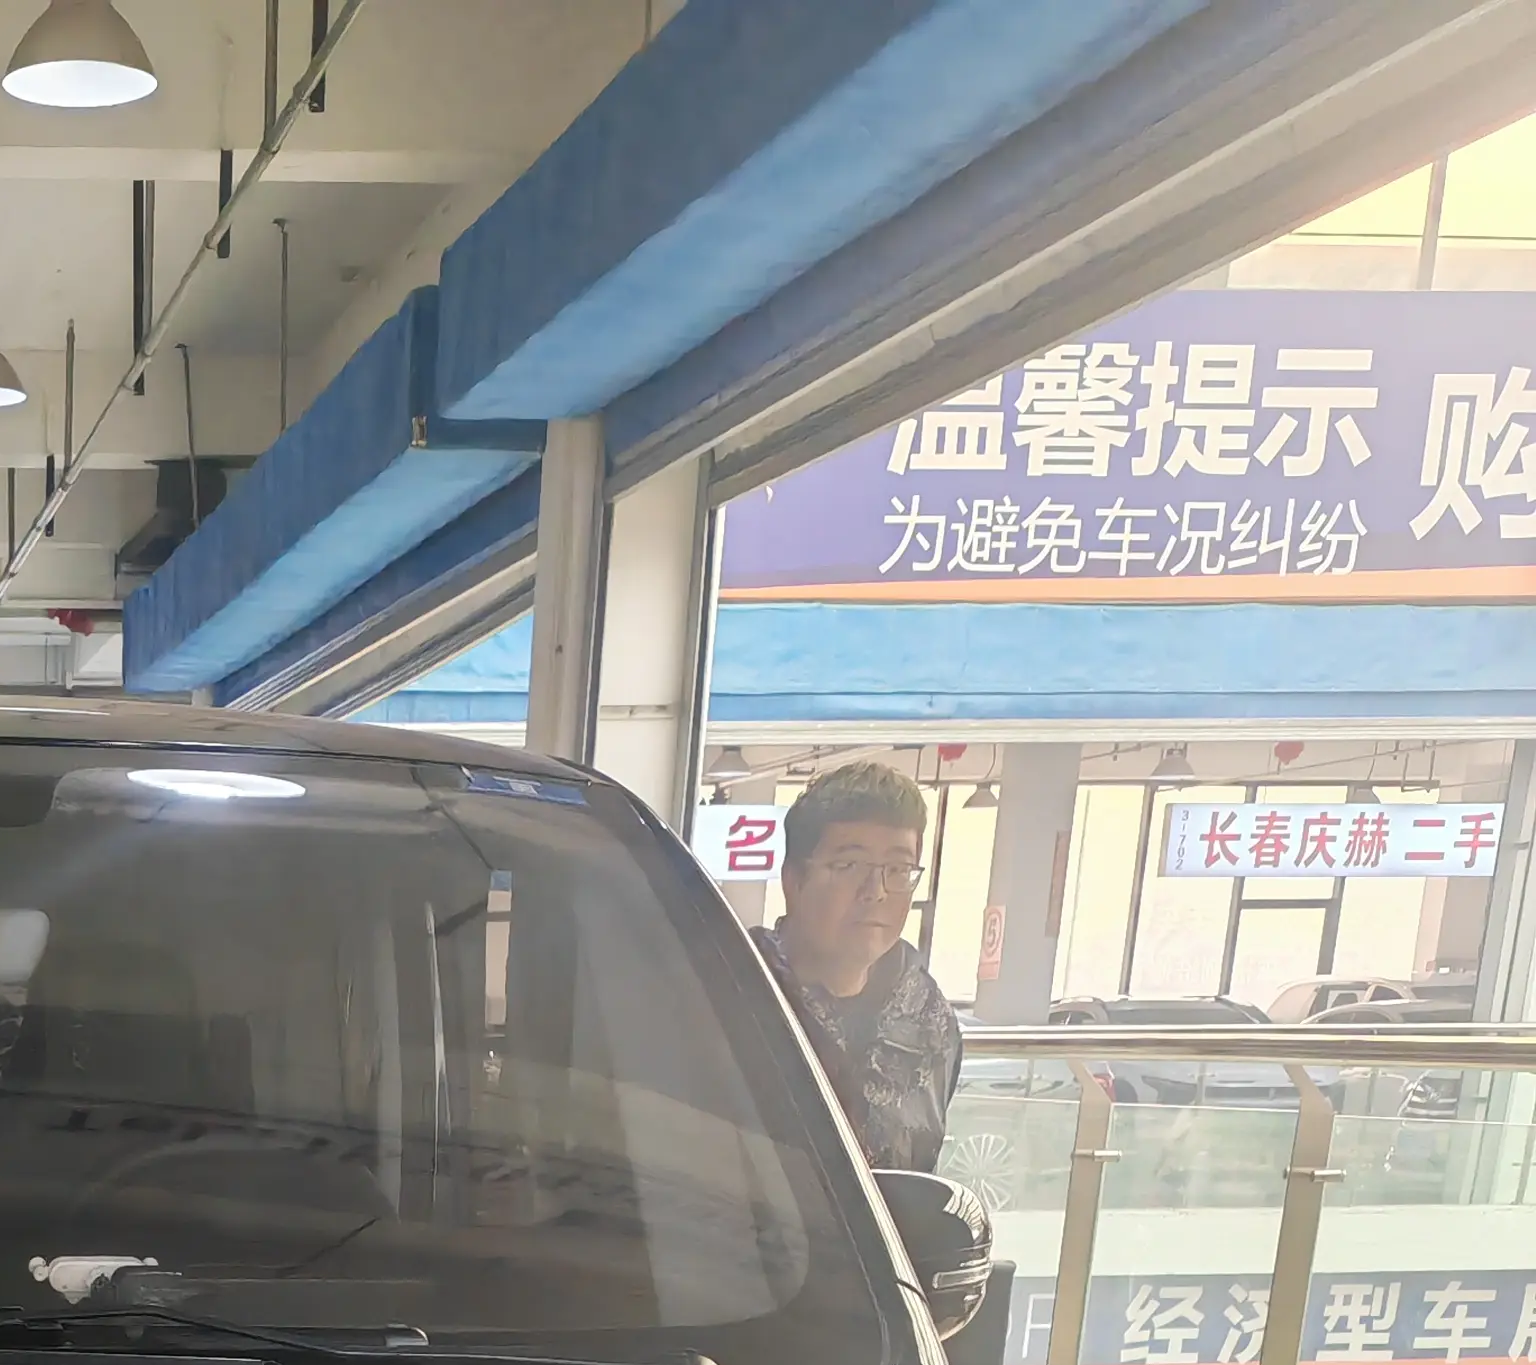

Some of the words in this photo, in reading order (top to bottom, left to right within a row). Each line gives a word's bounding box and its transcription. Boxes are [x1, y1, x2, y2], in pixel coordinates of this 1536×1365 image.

[887, 341, 1381, 477] 温馨提示
[877, 494, 1369, 577] 为避免车况纠纷
[725, 815, 776, 872] 名
